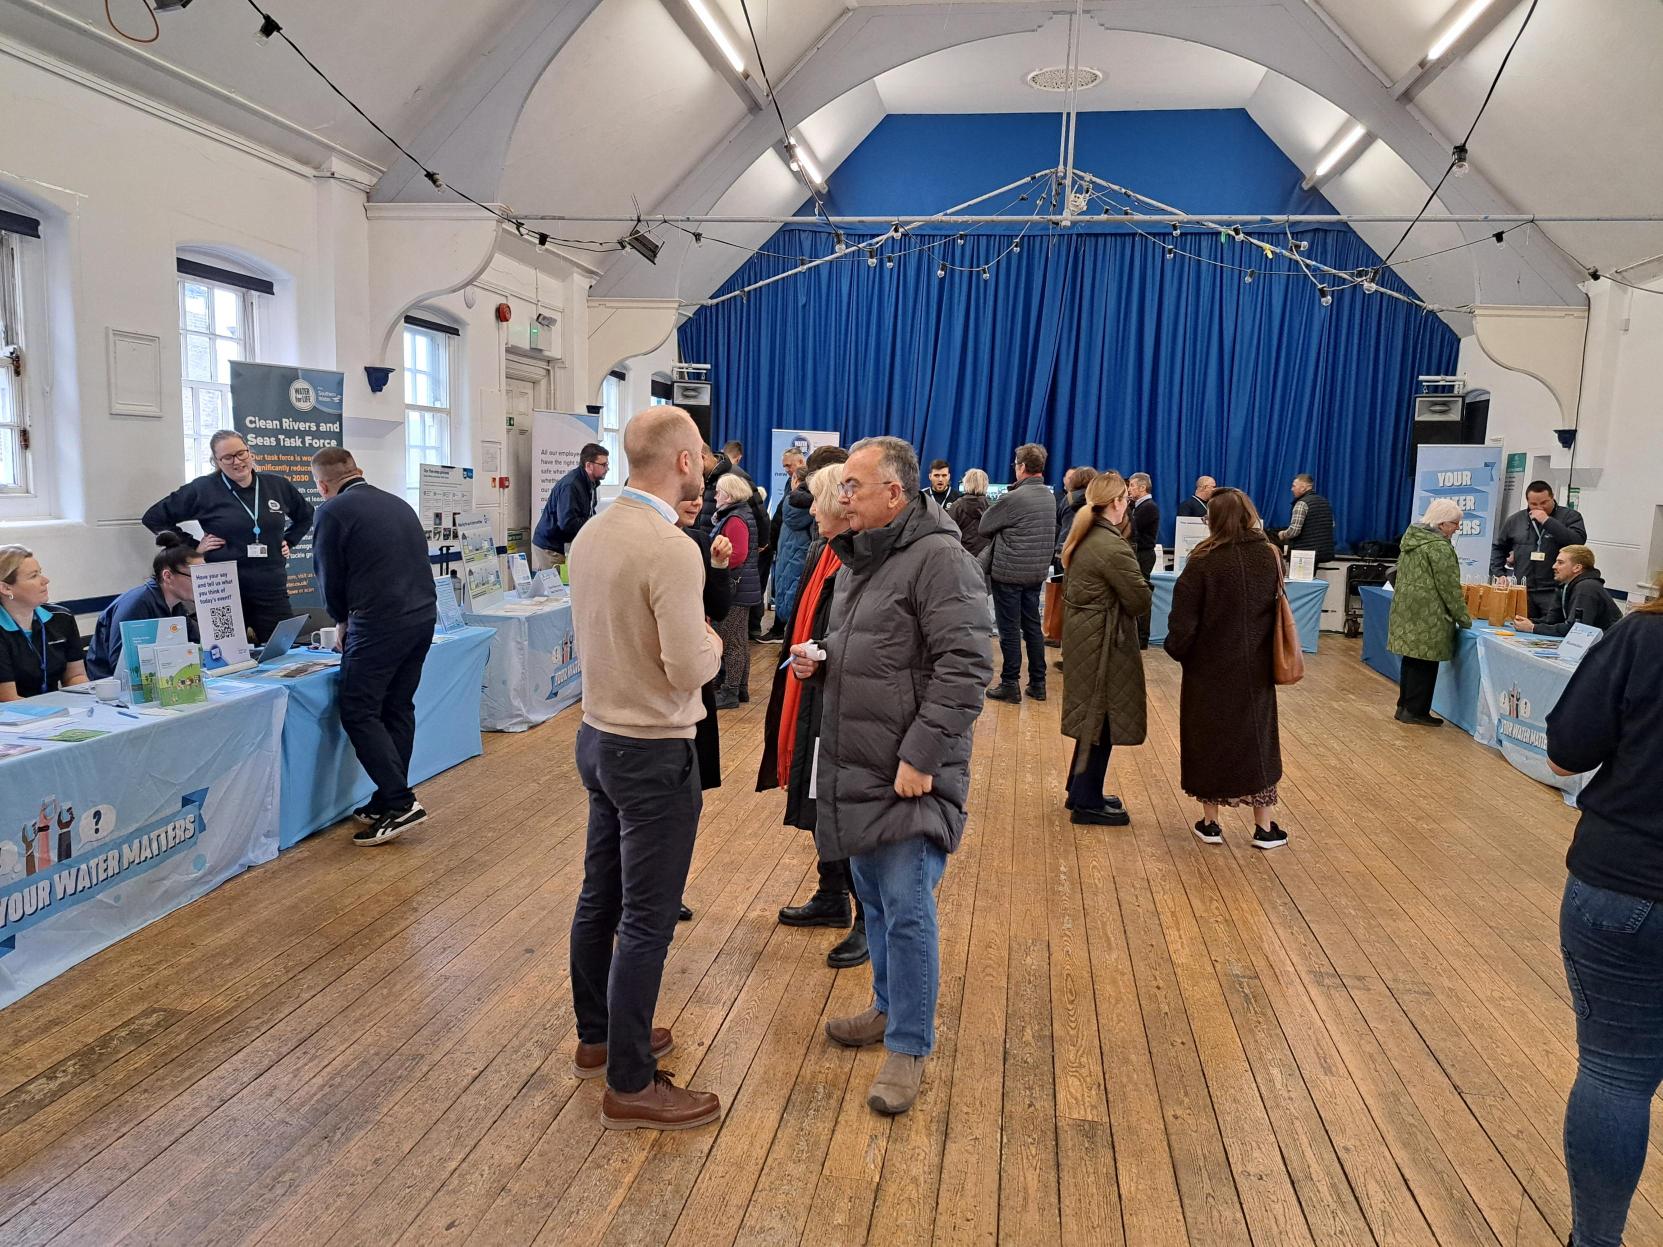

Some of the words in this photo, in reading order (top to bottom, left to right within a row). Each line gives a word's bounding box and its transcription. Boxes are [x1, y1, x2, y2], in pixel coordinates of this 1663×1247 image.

[294, 387, 310, 396] WATER
[245, 416, 280, 429] Clean
[282, 418, 317, 431] Rivers
[319, 421, 341, 432] and
[247, 433, 277, 446] Seas
[278, 434, 303, 447] Task
[305, 436, 338, 448] Force
[279, 453, 295, 461] force
[558, 450, 581, 458] employe
[255, 464, 290, 472] ignificantly
[292, 474, 310, 482] 2030
[1437, 470, 1473, 488] YOUR
[0, 879, 52, 929] YOUR
[53, 849, 121, 902] WATER
[123, 814, 196, 871] MATTERS
